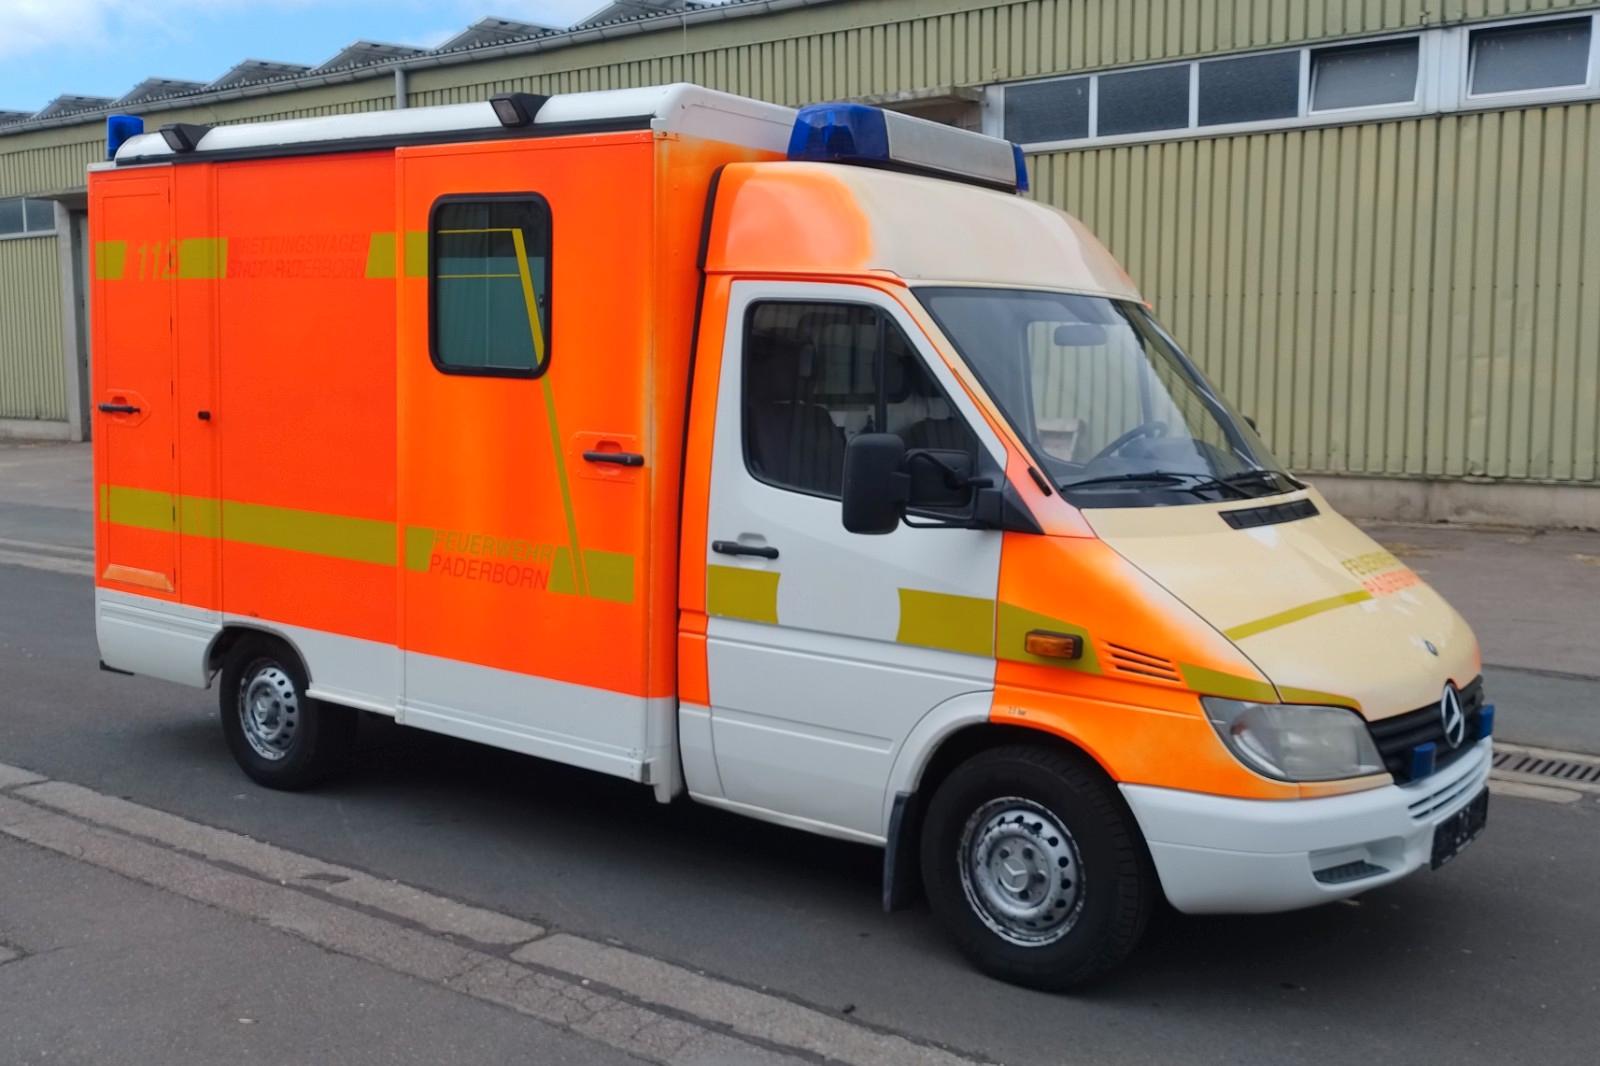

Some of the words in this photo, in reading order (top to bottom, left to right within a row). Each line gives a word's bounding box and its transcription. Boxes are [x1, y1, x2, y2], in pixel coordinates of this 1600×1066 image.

[136, 240, 179, 281] 112
[432, 529, 552, 564] FEUERWEHR
[430, 553, 549, 591] PADERBORN
